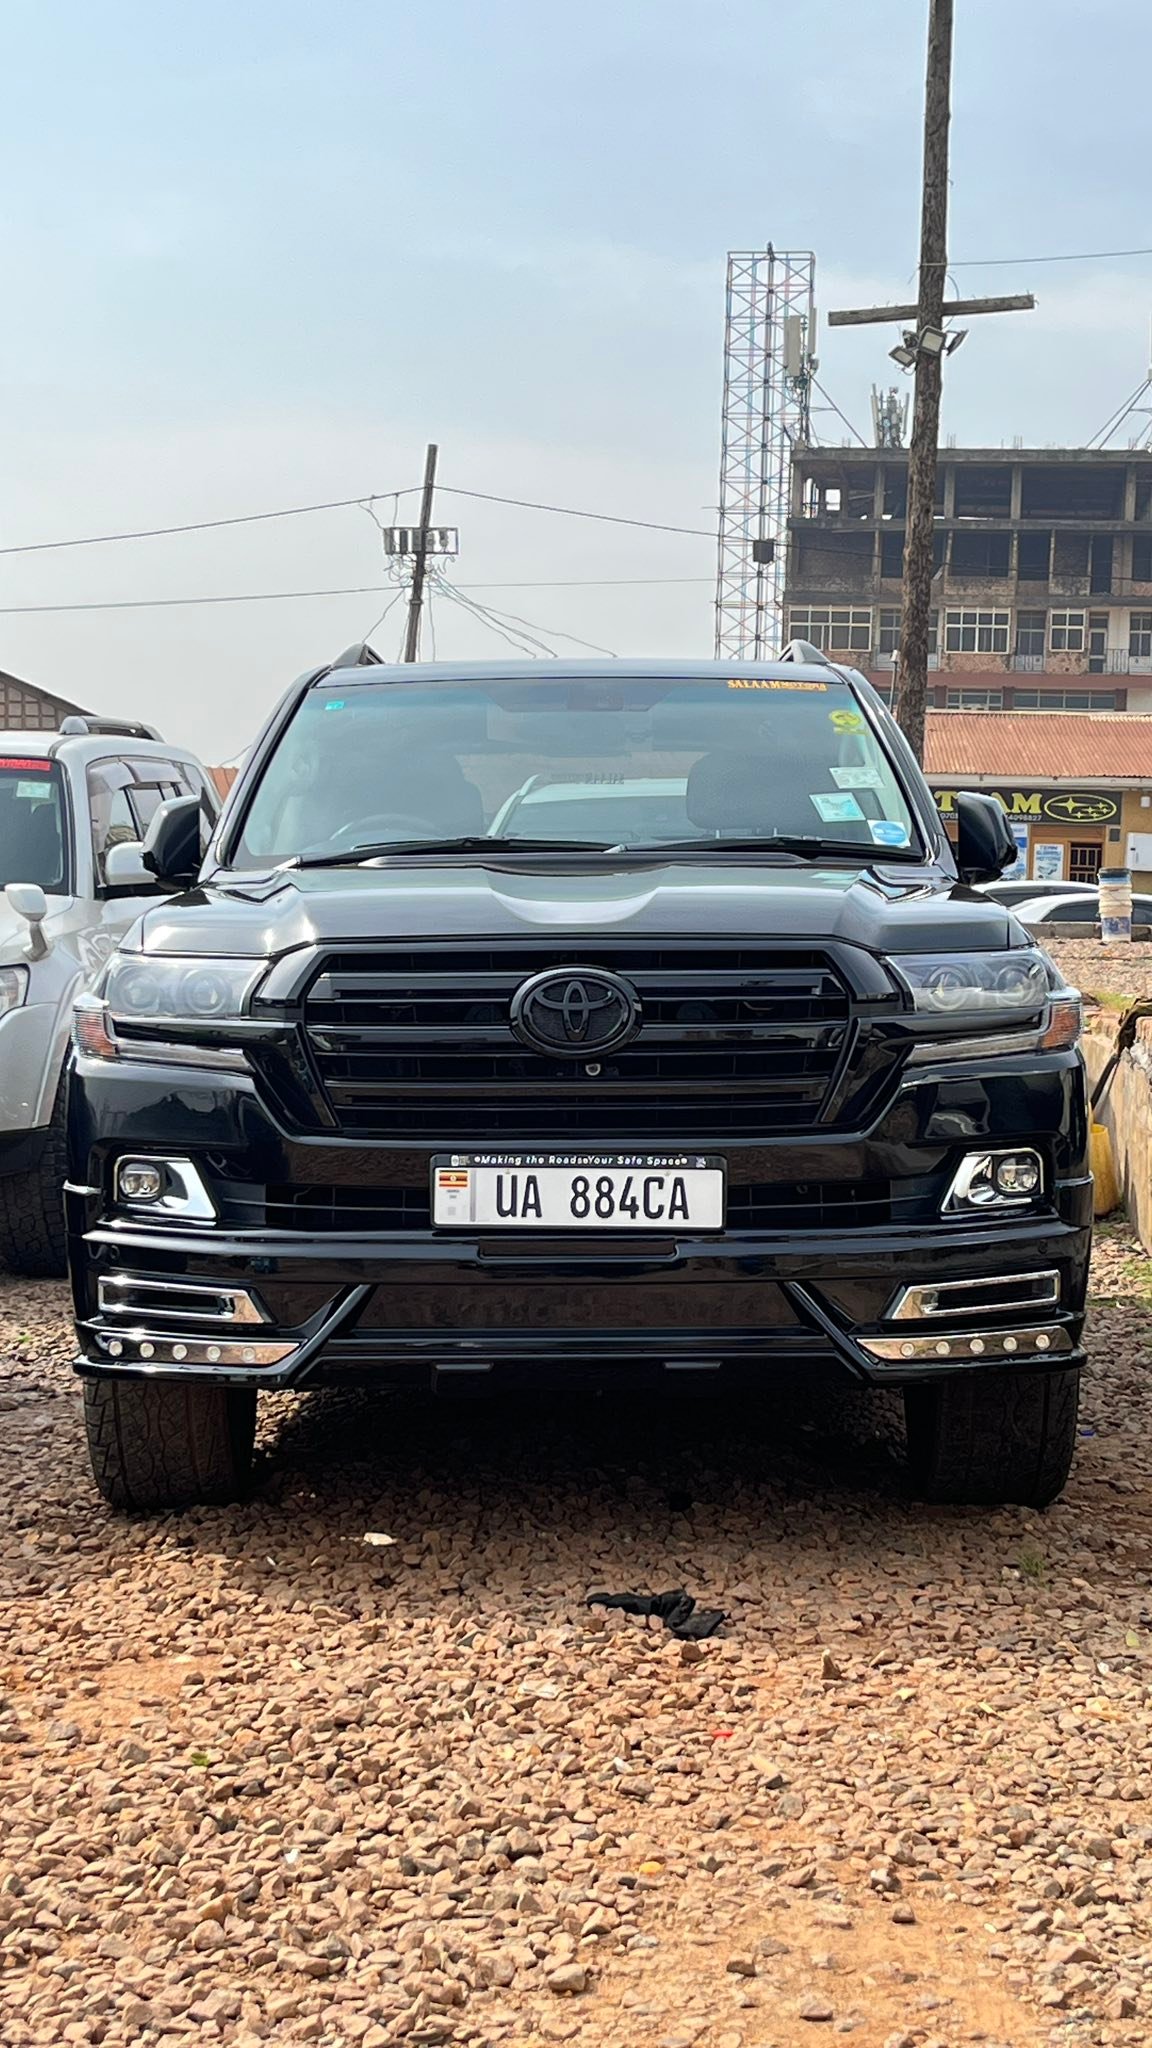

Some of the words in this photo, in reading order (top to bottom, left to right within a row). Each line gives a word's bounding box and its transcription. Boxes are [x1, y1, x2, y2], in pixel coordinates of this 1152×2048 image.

[727, 679, 780, 689] SALAAM
[481, 1155, 520, 1166] Making
[526, 1155, 545, 1164] the
[617, 1155, 643, 1165] Safe
[646, 1156, 680, 1167] Space
[496, 1174, 542, 1218] UA
[570, 1175, 690, 1220] 884CA
